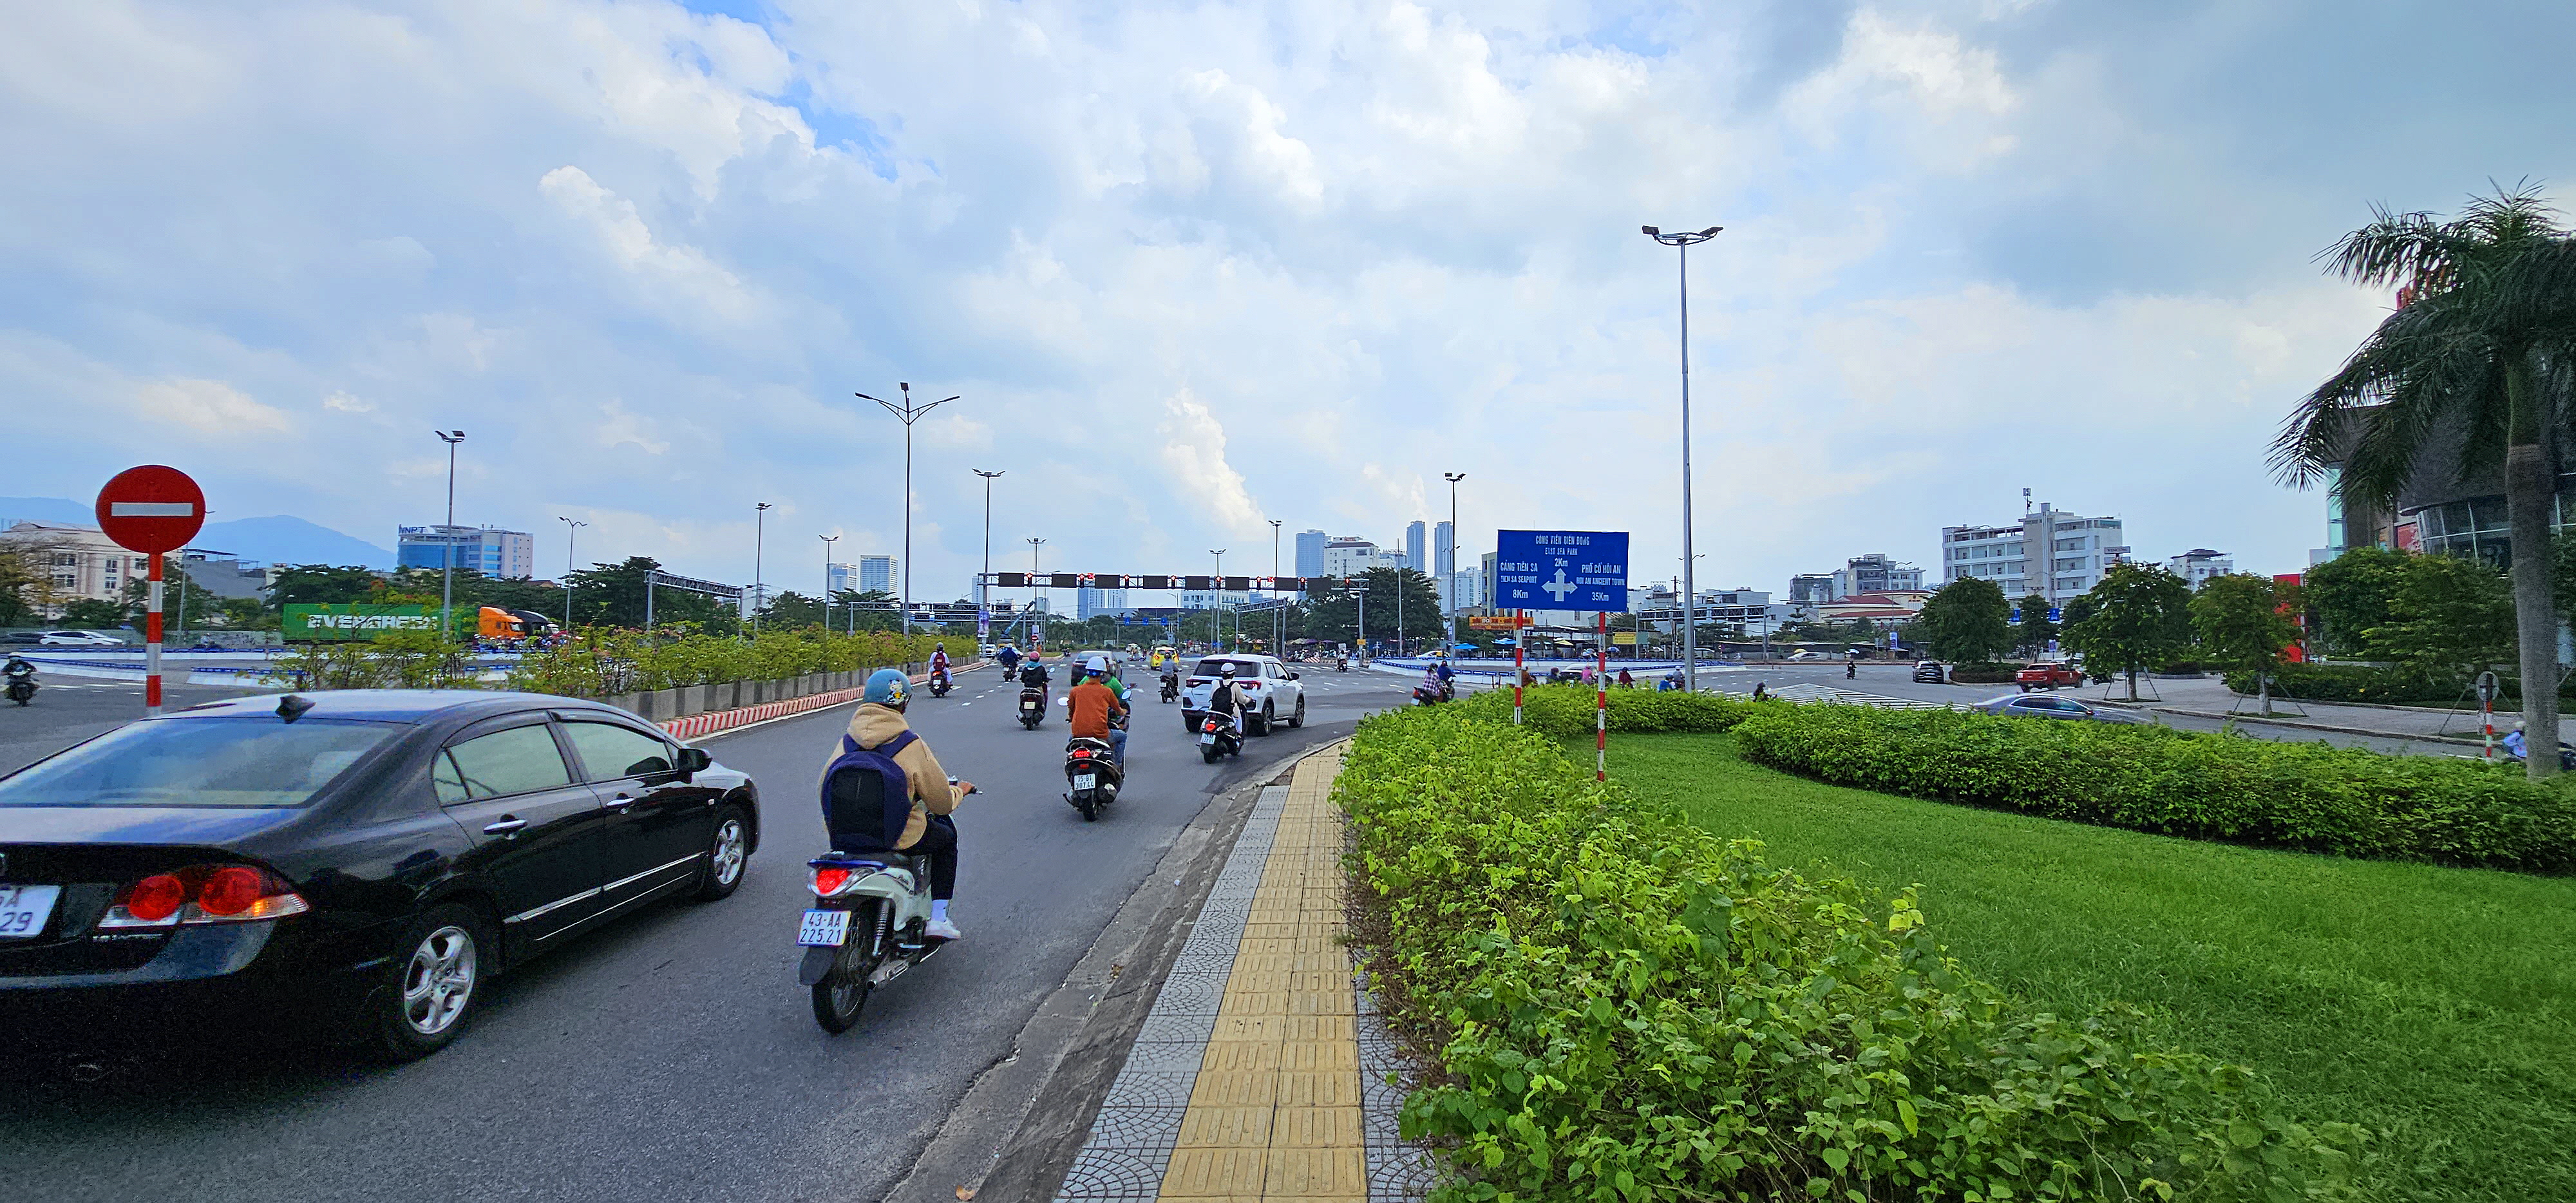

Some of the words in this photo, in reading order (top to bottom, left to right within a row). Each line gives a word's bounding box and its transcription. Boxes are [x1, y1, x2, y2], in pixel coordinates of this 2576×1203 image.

[1530, 562, 1538, 572] SA
[1554, 558, 1568, 567] 2Km
[1613, 565, 1621, 574] AN
[1518, 575, 1537, 583] SEAPORT
[1512, 589, 1528, 598] 8Km
[1591, 591, 1609, 601] 35Km
[307, 614, 438, 630] EVERGREEN
[808, 913, 841, 927] 43-AA
[799, 928, 841, 943] 225.21
